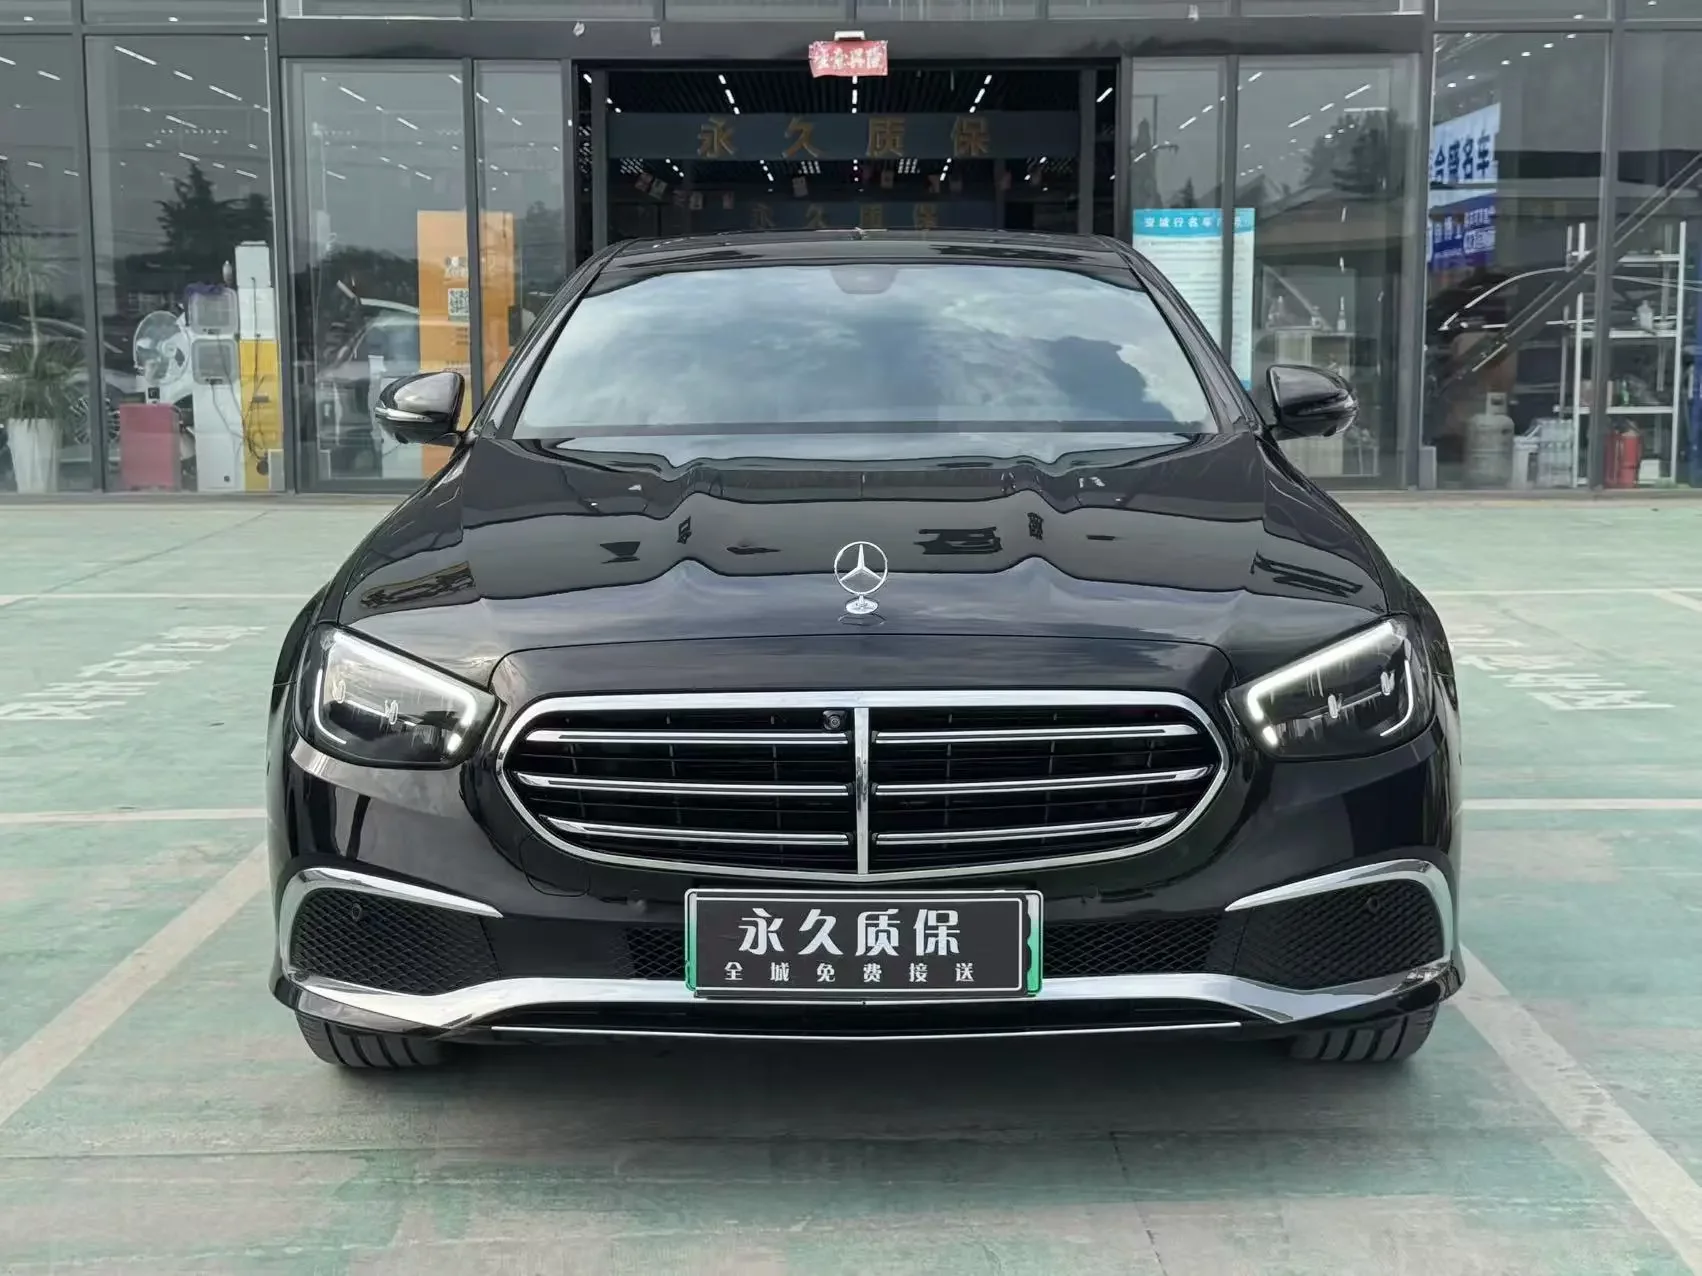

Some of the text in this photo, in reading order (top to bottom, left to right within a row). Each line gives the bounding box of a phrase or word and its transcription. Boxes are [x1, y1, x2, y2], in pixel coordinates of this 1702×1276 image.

[697, 116, 990, 158] 永久质保
[737, 907, 961, 957] 永久质保
[723, 961, 976, 983] 全城免费接送
